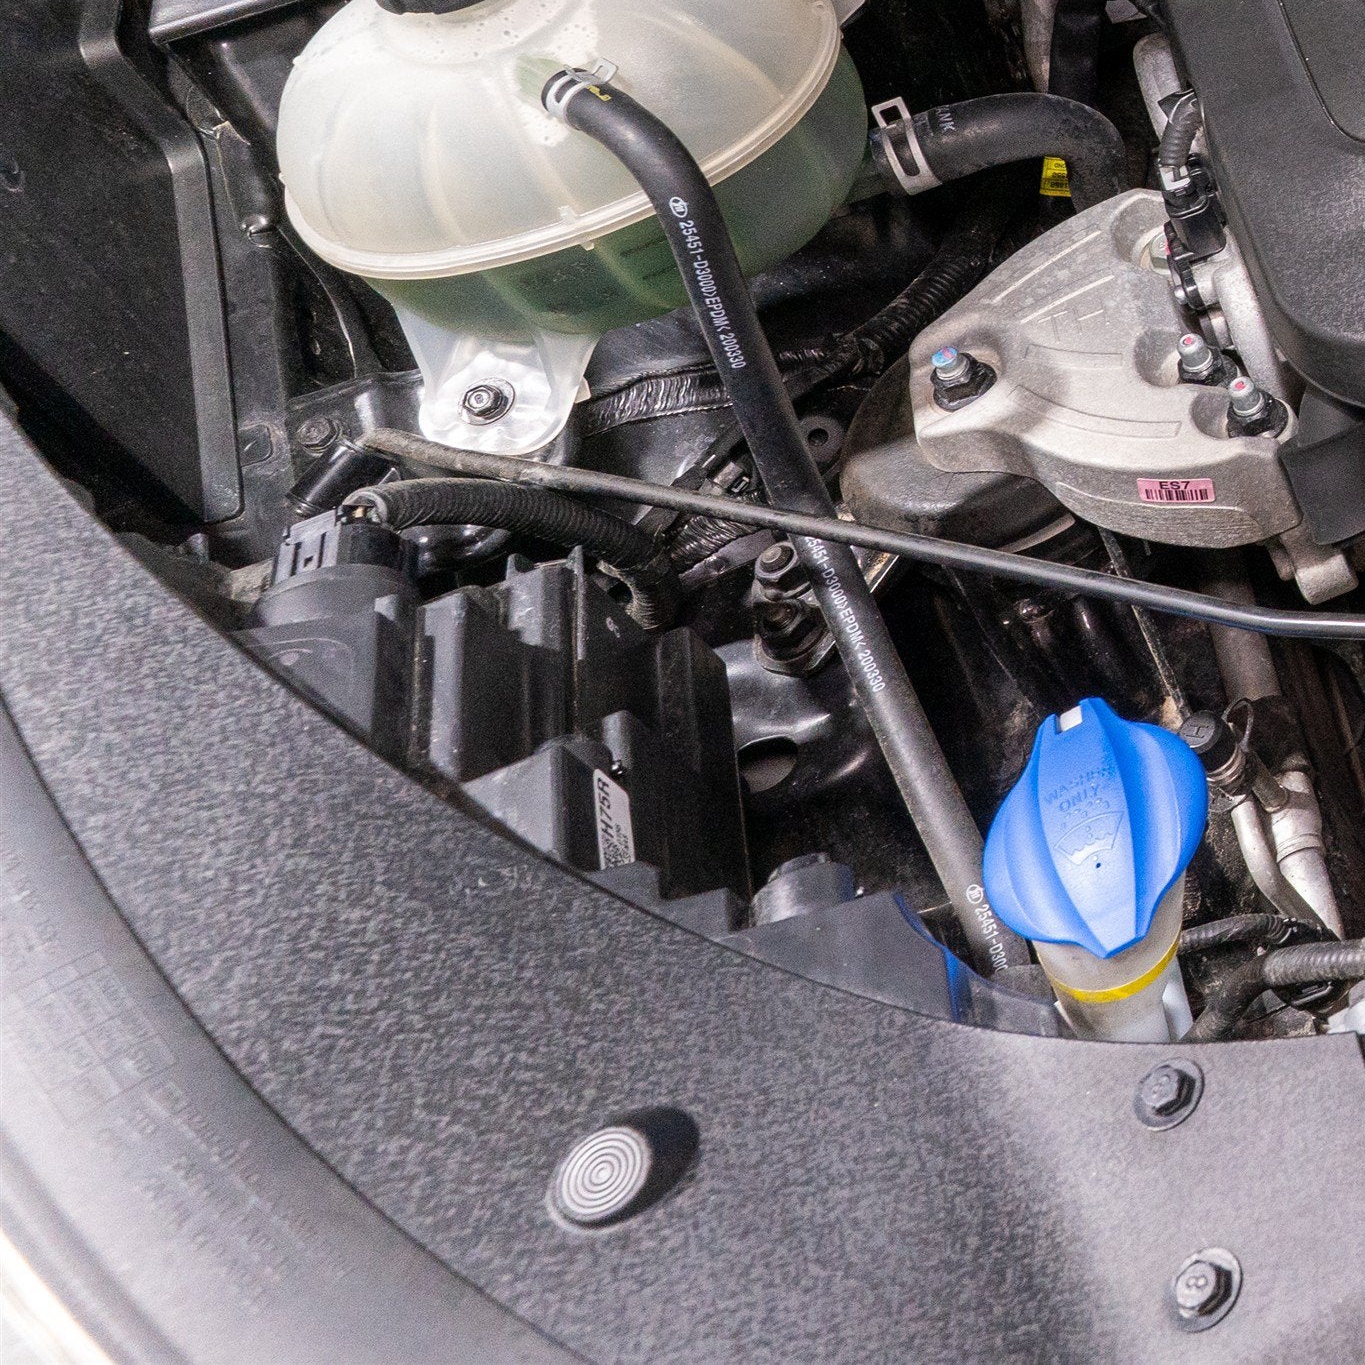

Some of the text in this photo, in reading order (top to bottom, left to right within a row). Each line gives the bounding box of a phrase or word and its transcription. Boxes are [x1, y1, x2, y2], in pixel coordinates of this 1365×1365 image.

[719, 332, 748, 370] 200330
[1158, 480, 1191, 490] ES7
[857, 649, 886, 693] 200330
[597, 777, 615, 839] H75R
